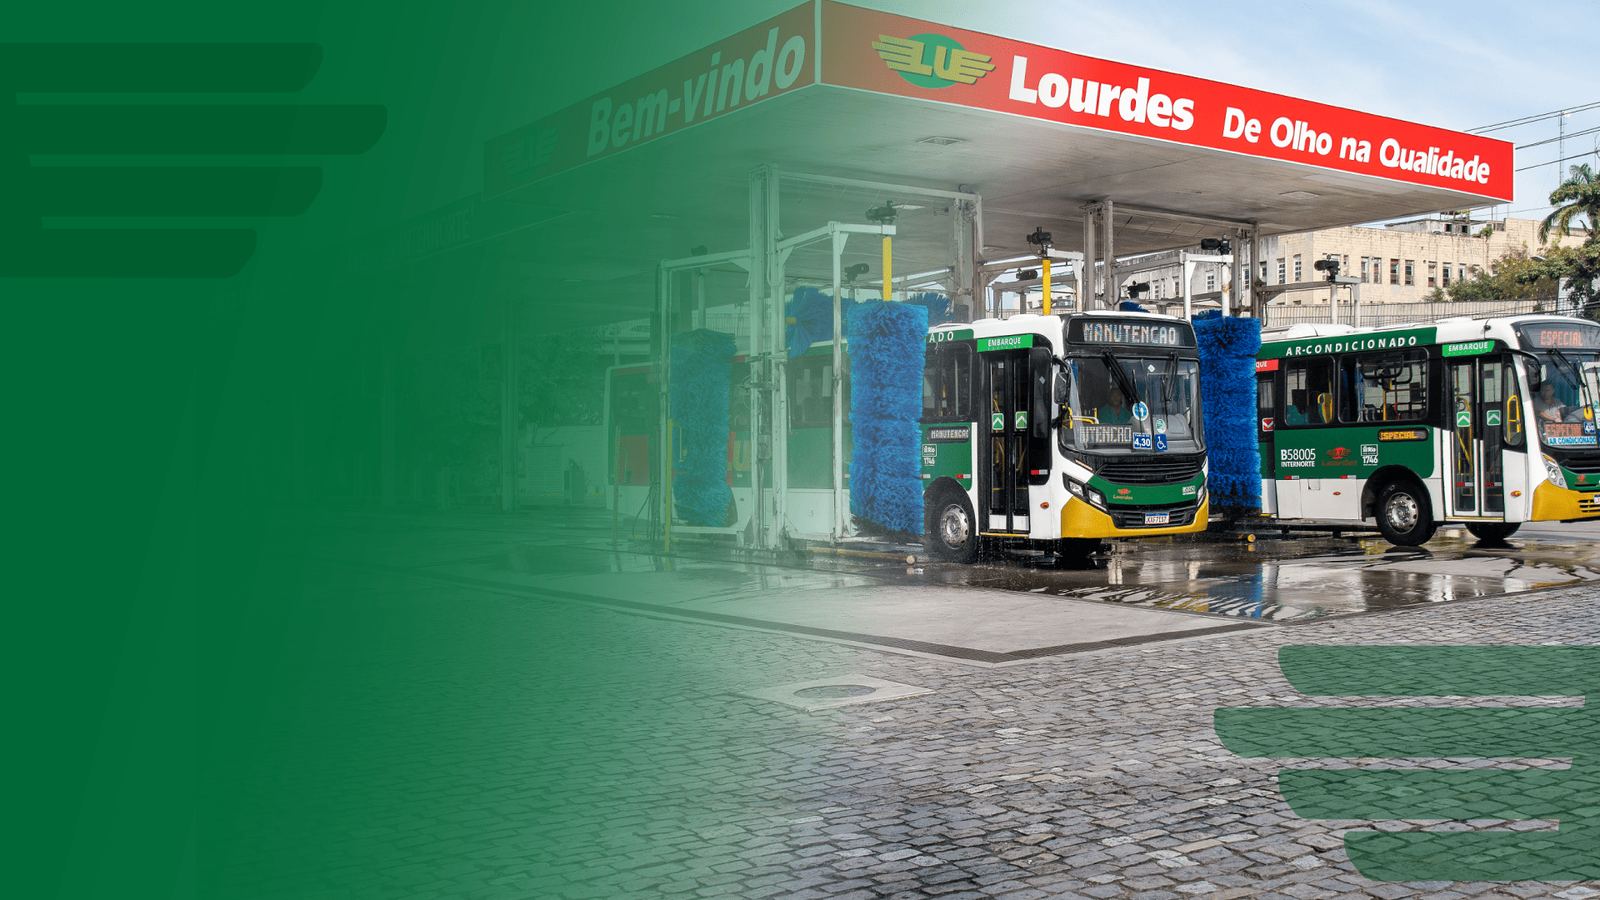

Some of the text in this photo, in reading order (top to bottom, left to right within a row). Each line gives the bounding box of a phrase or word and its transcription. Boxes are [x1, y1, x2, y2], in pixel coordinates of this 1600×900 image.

[586, 26, 806, 158] Bem-vindo
[1009, 55, 1195, 131] Lourdes
[1222, 106, 1490, 184] De Olho na Qualidade
[987, 337, 1022, 347] EMBARQUE
[1540, 330, 1583, 346] ESPECIAL
[1286, 336, 1417, 356] AR-CONDICIONADO
[1448, 341, 1488, 352] EMBARQUE
[1281, 449, 1316, 461] B58005
[1362, 455, 1379, 464] 1746
[1281, 460, 1315, 468] INTERNORTE
